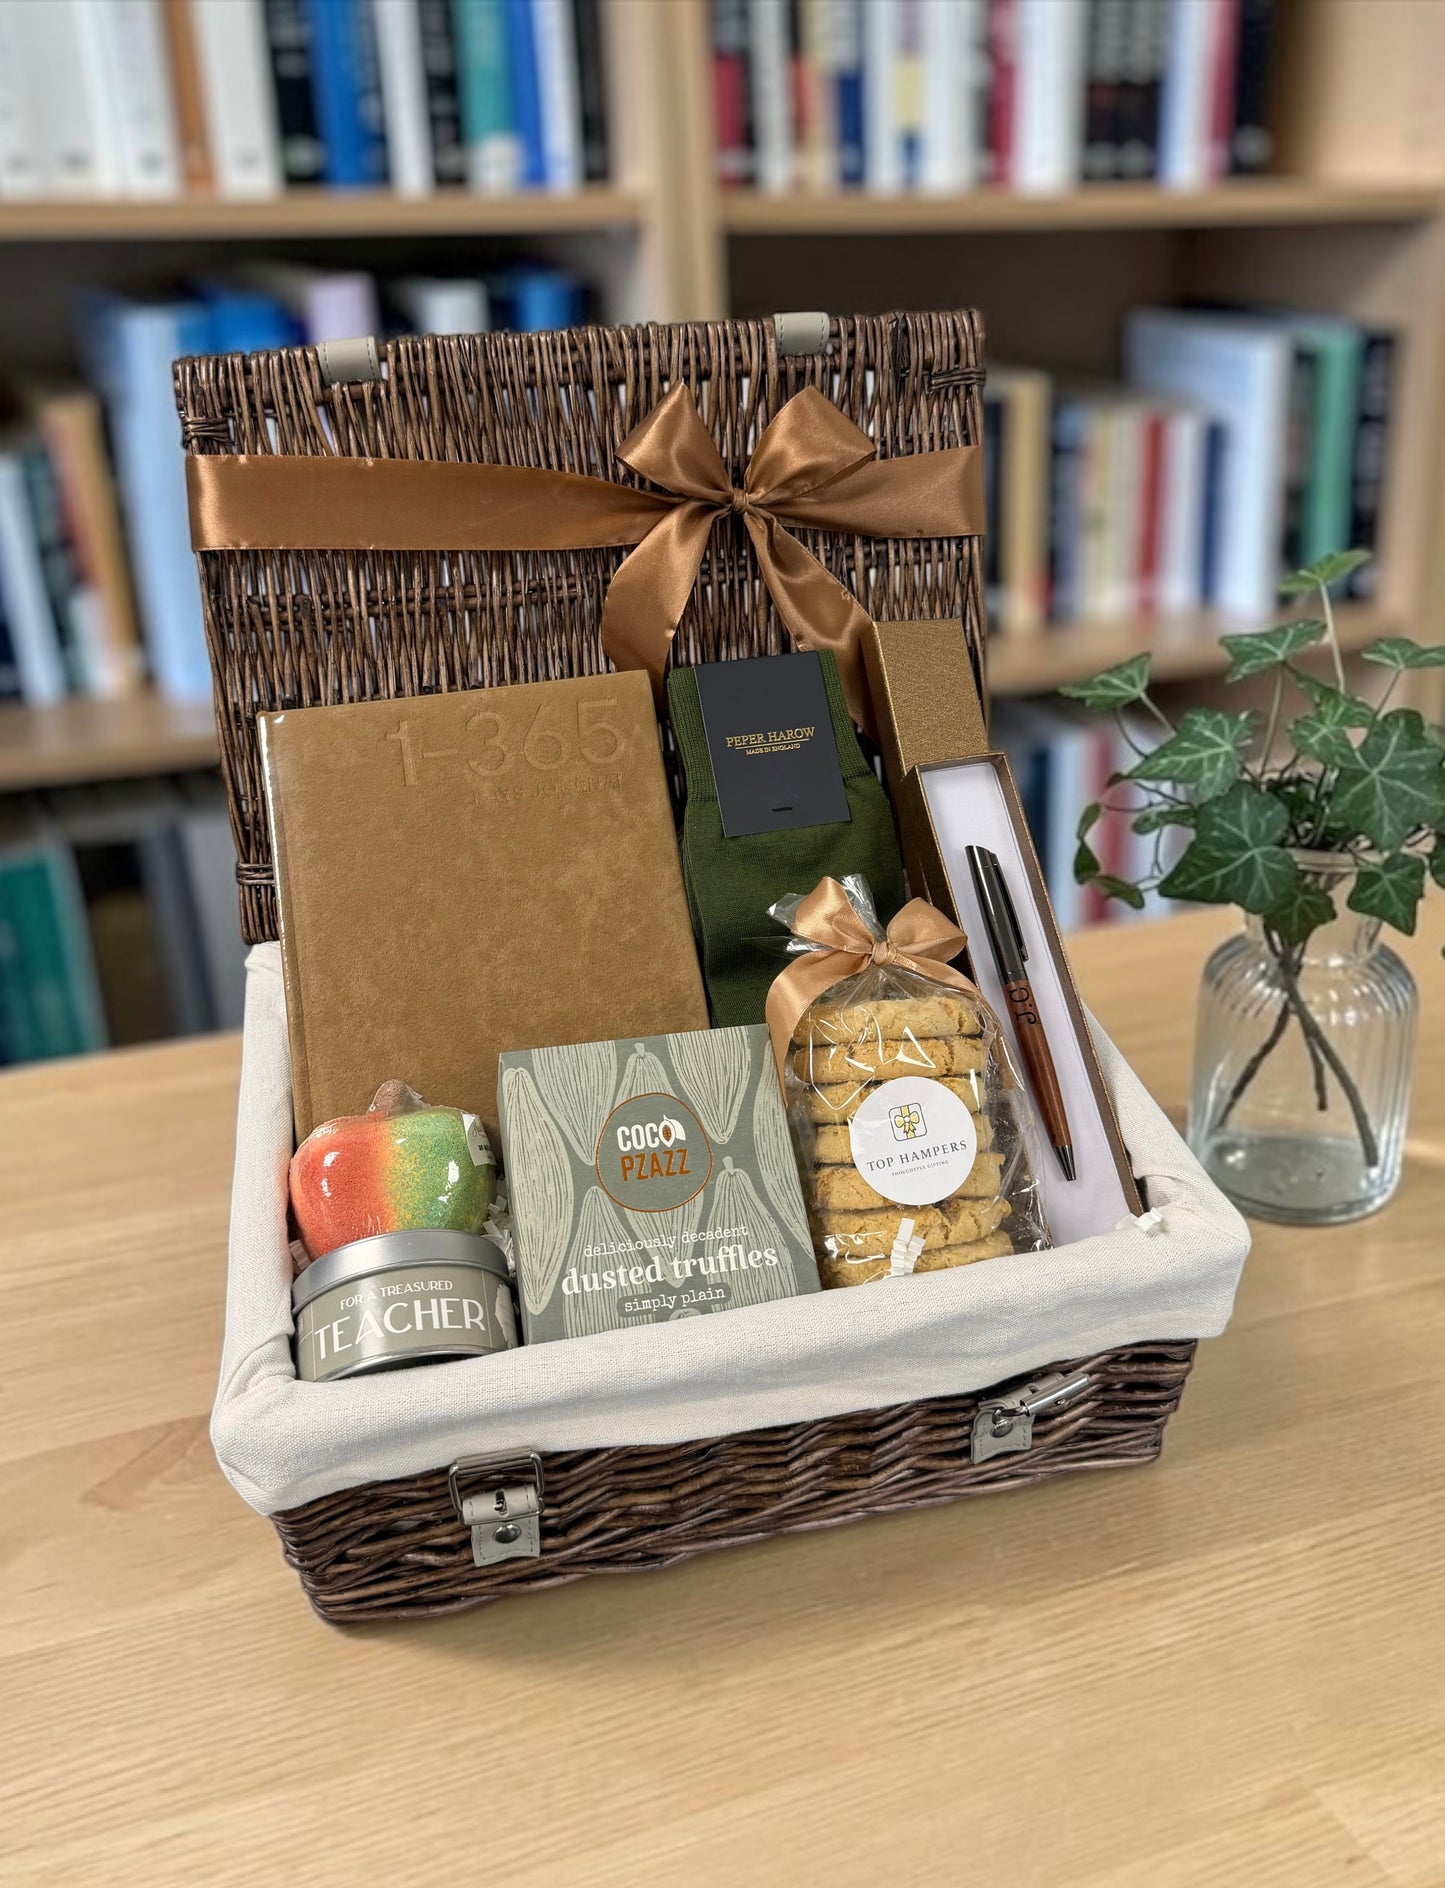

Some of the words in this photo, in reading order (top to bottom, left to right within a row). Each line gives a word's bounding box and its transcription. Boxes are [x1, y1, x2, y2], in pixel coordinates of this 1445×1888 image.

[384, 699, 627, 787] 1-365
[725, 733, 767, 748] PEPER
[767, 726, 816, 742] HAROW
[745, 747, 764, 755] MADE
[771, 743, 801, 752] ENGLAND
[616, 1116, 686, 1151] COCO
[620, 1148, 692, 1182] PZAZZ
[866, 1156, 894, 1172] TOP
[899, 1139, 968, 1165] HAMPERS
[927, 1159, 950, 1169] GIFTING
[583, 1234, 677, 1258] deliciously
[681, 1224, 749, 1244] decadent
[561, 1256, 665, 1296] dusted
[671, 1244, 779, 1280] truffles
[340, 1296, 363, 1310] FOR
[368, 1290, 377, 1300] A
[379, 1280, 453, 1298] TREASURED
[624, 1291, 677, 1313] simply
[681, 1286, 726, 1309] plain
[314, 1298, 487, 1360] TEACHER
